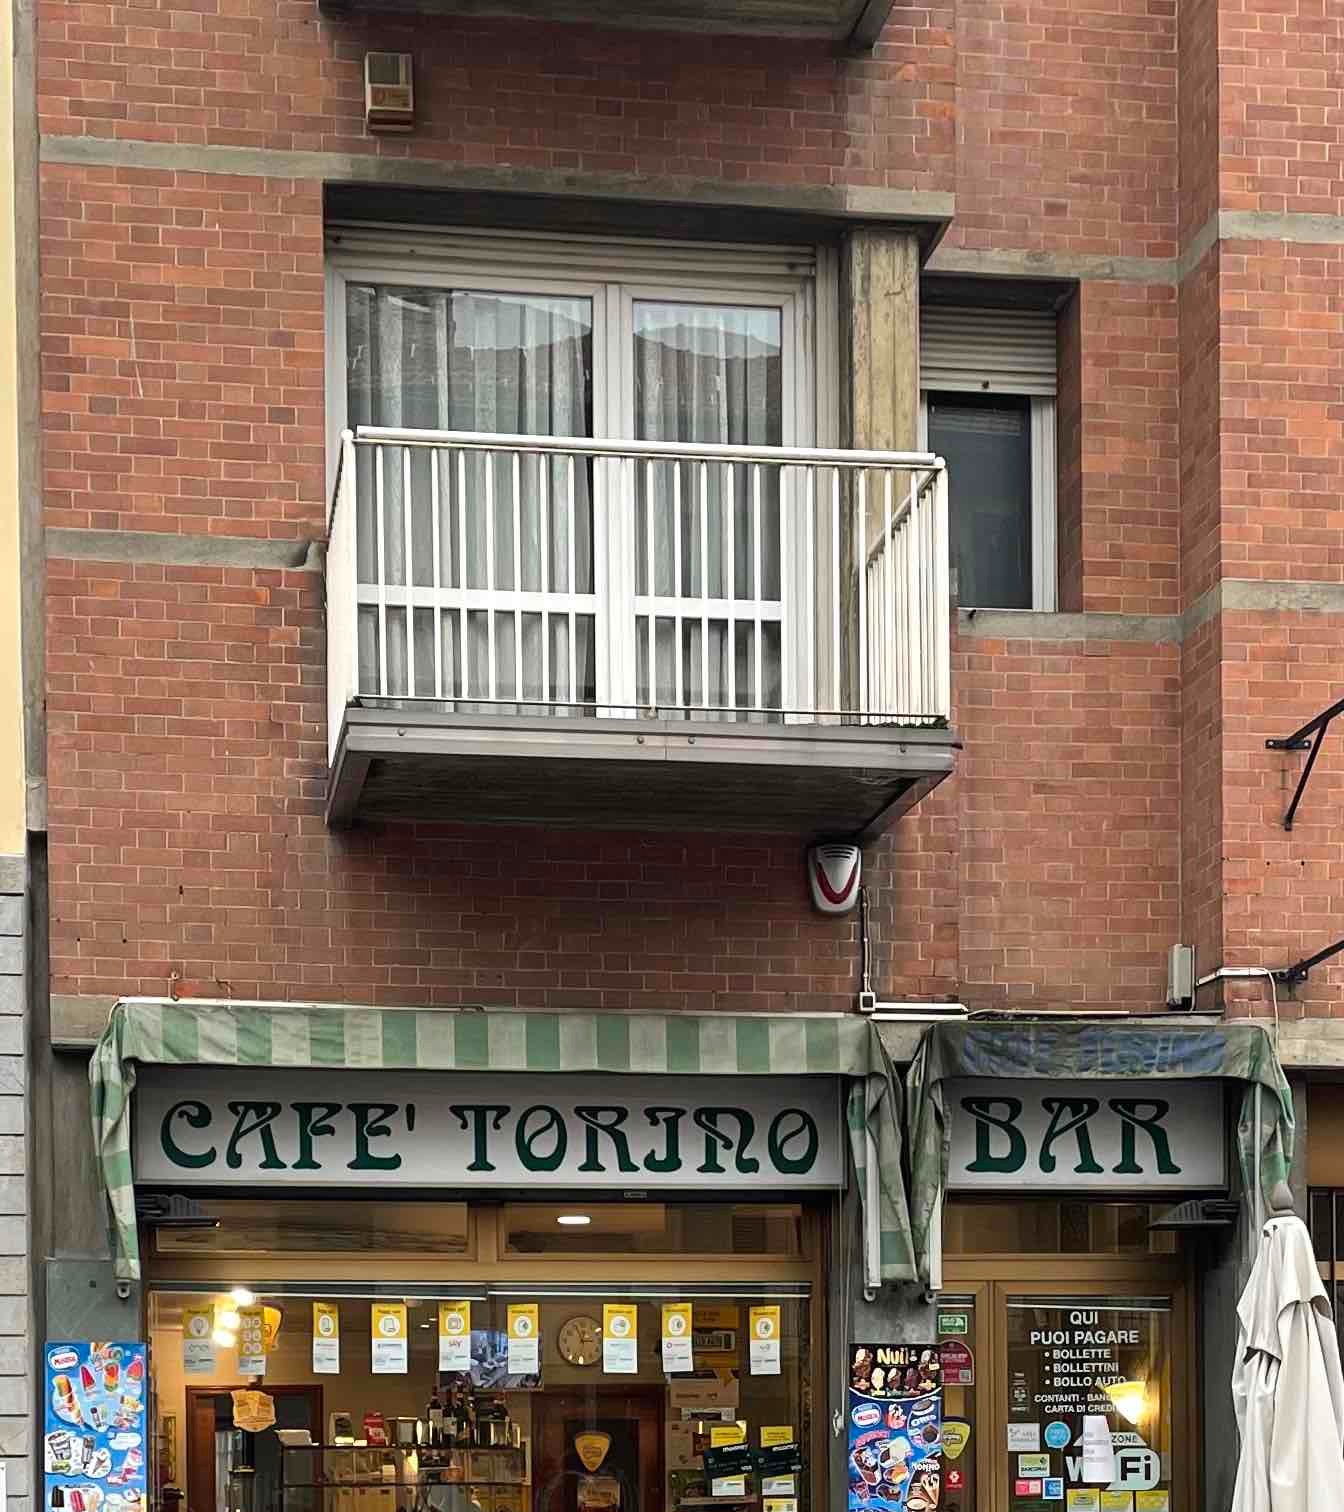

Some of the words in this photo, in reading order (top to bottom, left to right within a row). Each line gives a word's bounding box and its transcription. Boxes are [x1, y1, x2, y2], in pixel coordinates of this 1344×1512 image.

[449, 1104, 820, 1176] TORINO
[960, 1096, 1182, 1176] BAR
[1069, 1311, 1099, 1326] QUI
[1030, 1331, 1070, 1345] PUOI
[1074, 1330, 1140, 1345] PAGARE
[1052, 1348, 1112, 1360] BOLLETTE
[1053, 1362, 1120, 1373] BOLLETTINI
[1053, 1376, 1092, 1387] BOLLO
[1034, 1393, 1080, 1403] CONTANTI
[1044, 1404, 1075, 1414] CARTA
[1076, 1404, 1086, 1414] DI
[1111, 1434, 1138, 1444] ZONE
